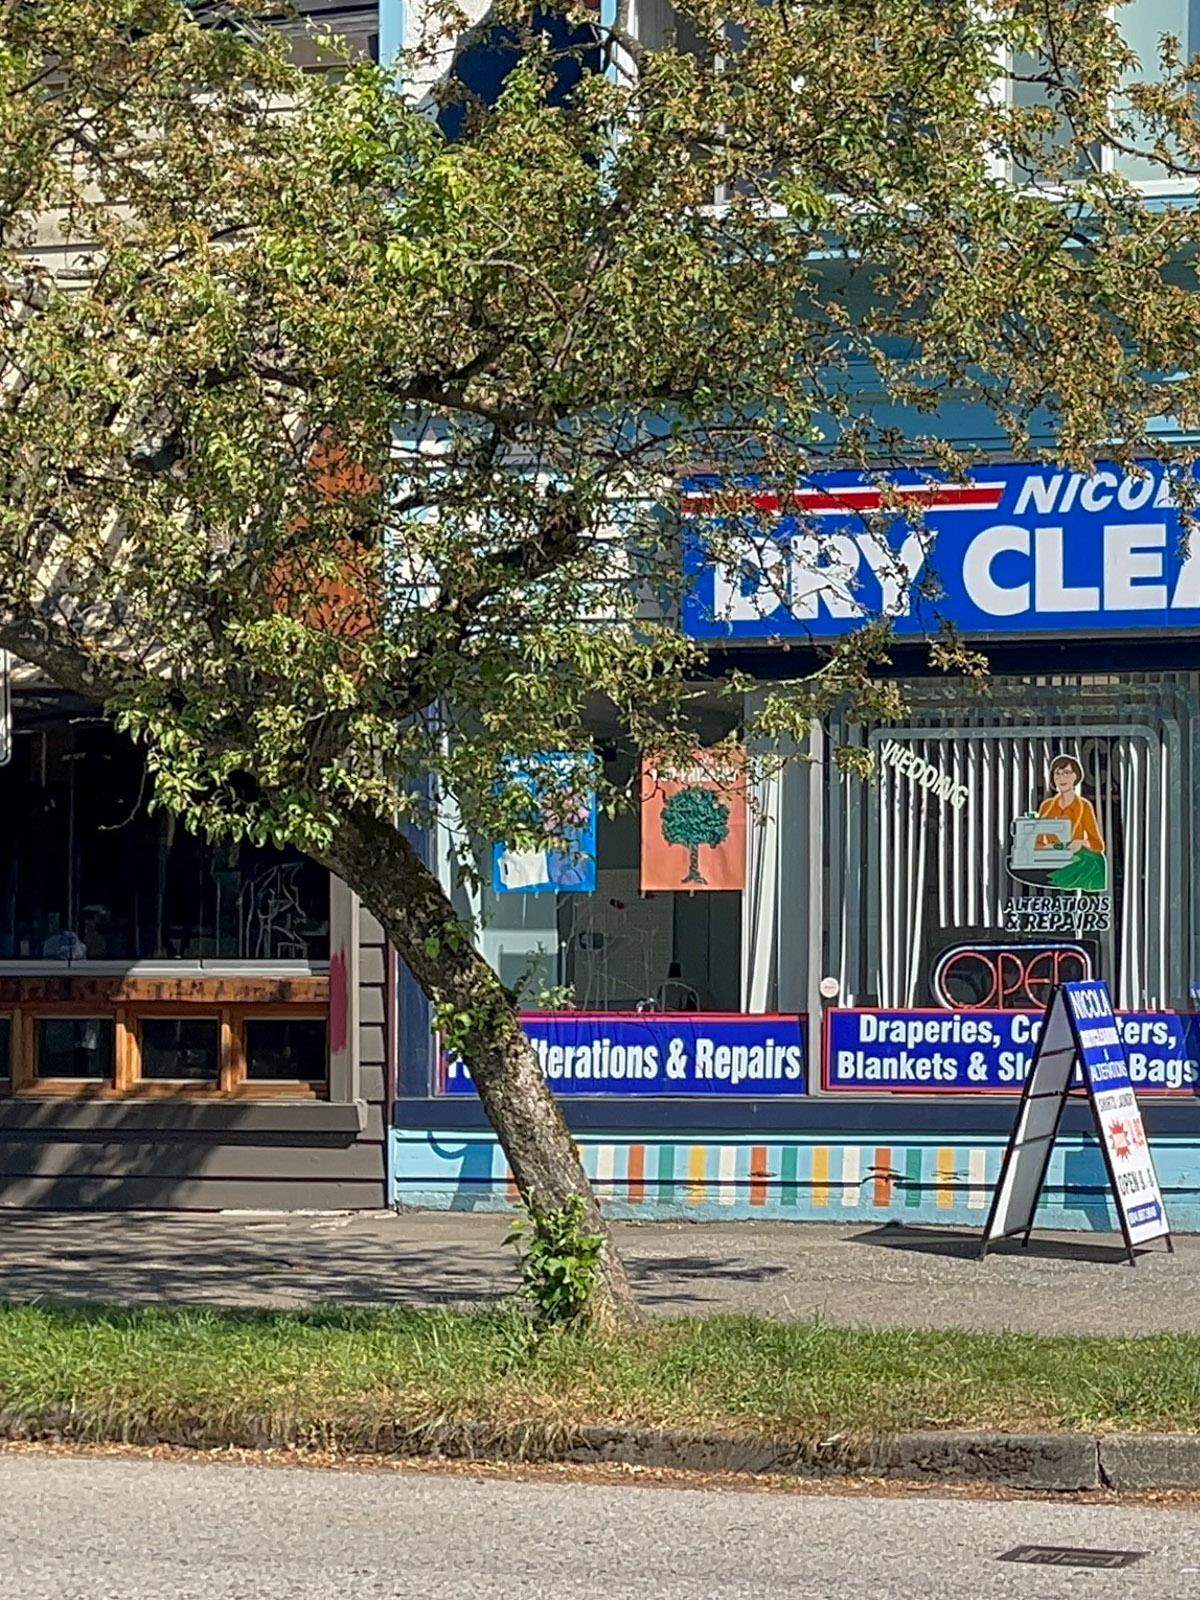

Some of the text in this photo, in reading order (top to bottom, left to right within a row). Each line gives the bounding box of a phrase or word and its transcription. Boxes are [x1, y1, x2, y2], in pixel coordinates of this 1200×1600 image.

[713, 529, 938, 621] DRY
[881, 739, 969, 809] WEDDING
[1003, 896, 1111, 913] ALTERATIONS
[1005, 911, 1111, 932] & REPAIRS
[1069, 989, 1113, 1020] NICOLA
[859, 1014, 1001, 1049] Draperies,
[666, 1038, 687, 1079] &
[695, 1038, 801, 1085] Repairs
[837, 1051, 958, 1080] Blankets
[967, 1051, 988, 1081] &
[1129, 1053, 1199, 1088] Bags
